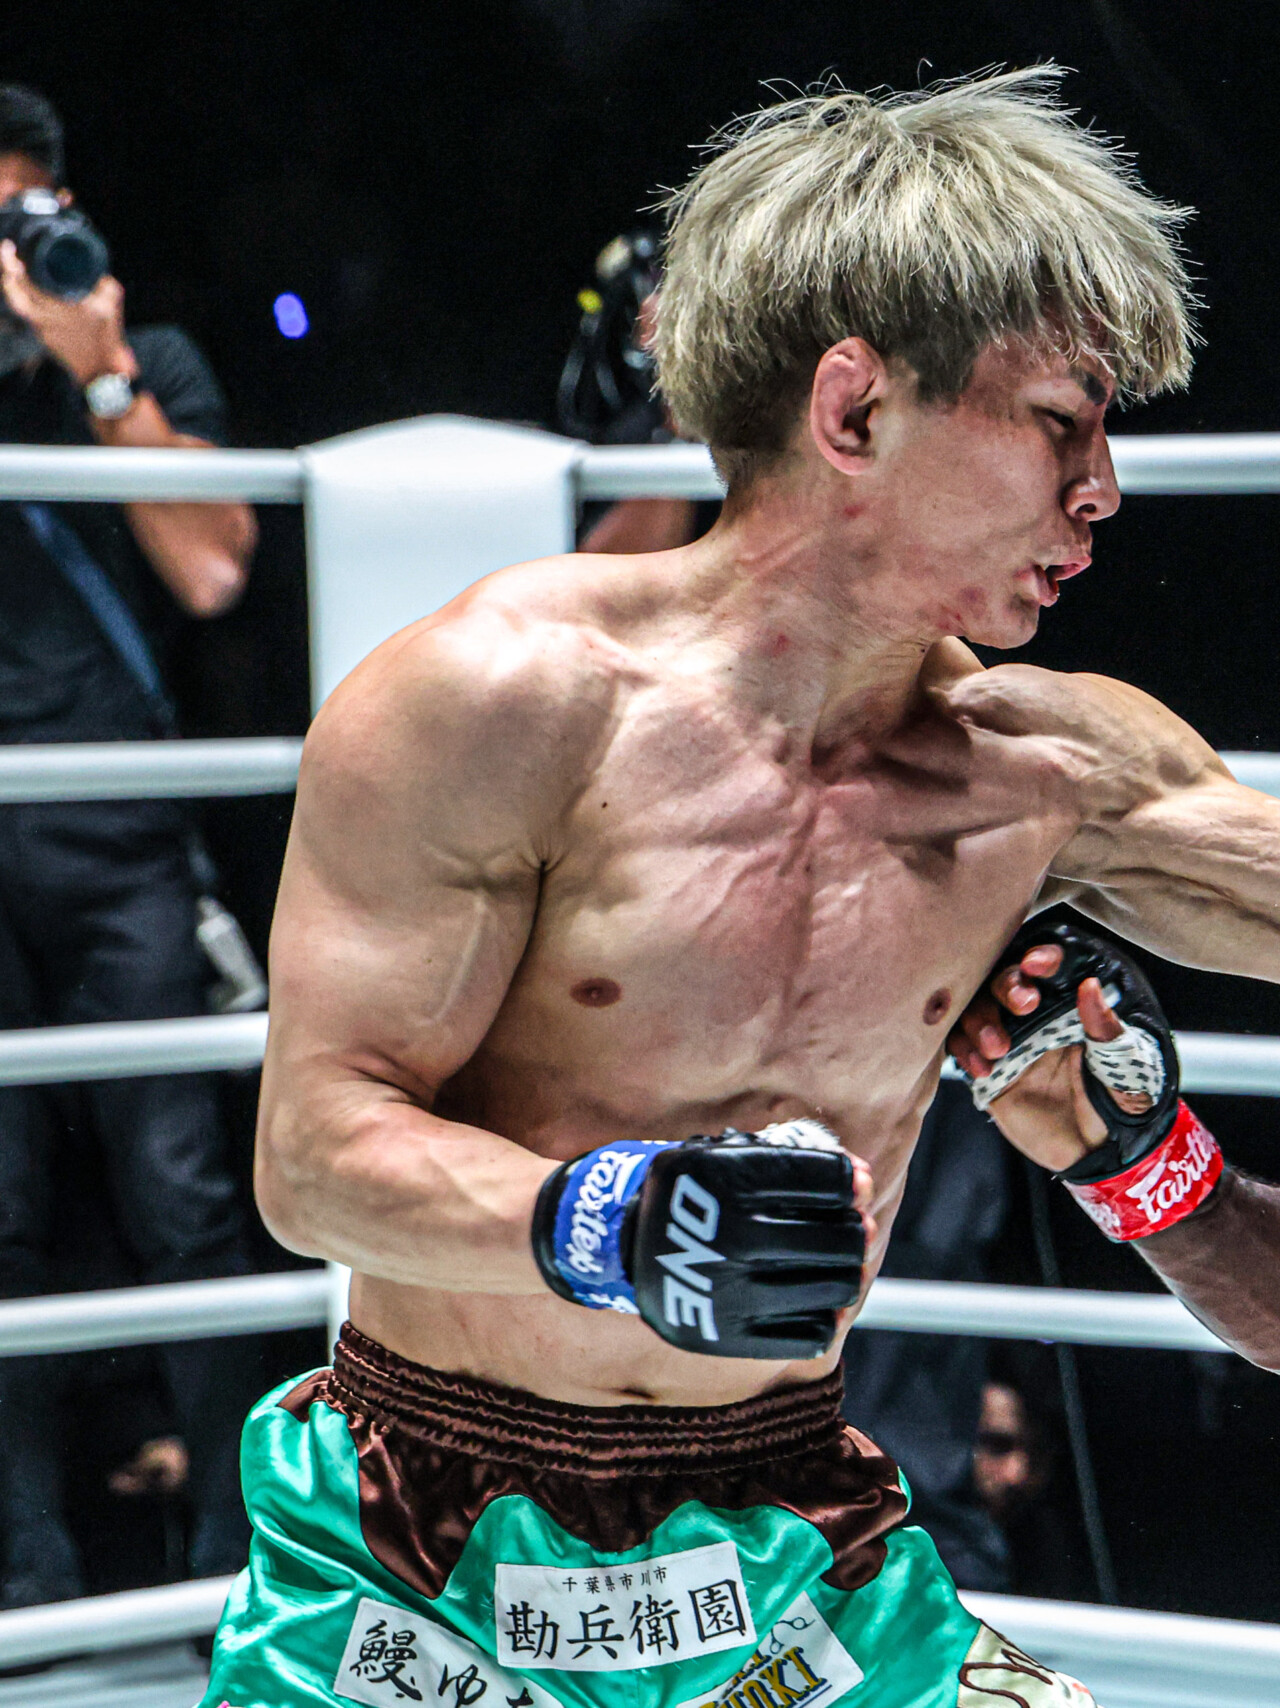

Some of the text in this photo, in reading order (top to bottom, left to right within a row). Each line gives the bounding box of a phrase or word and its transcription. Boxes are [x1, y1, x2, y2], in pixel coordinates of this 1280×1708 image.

[565, 1150, 647, 1273] Fairtex
[655, 1173, 727, 1342] ONE
[505, 1579, 747, 1660] 勘兵衛園
[561, 1566, 667, 1594] 千葉県市川市
[349, 1619, 534, 1708] 鰻ゆ
